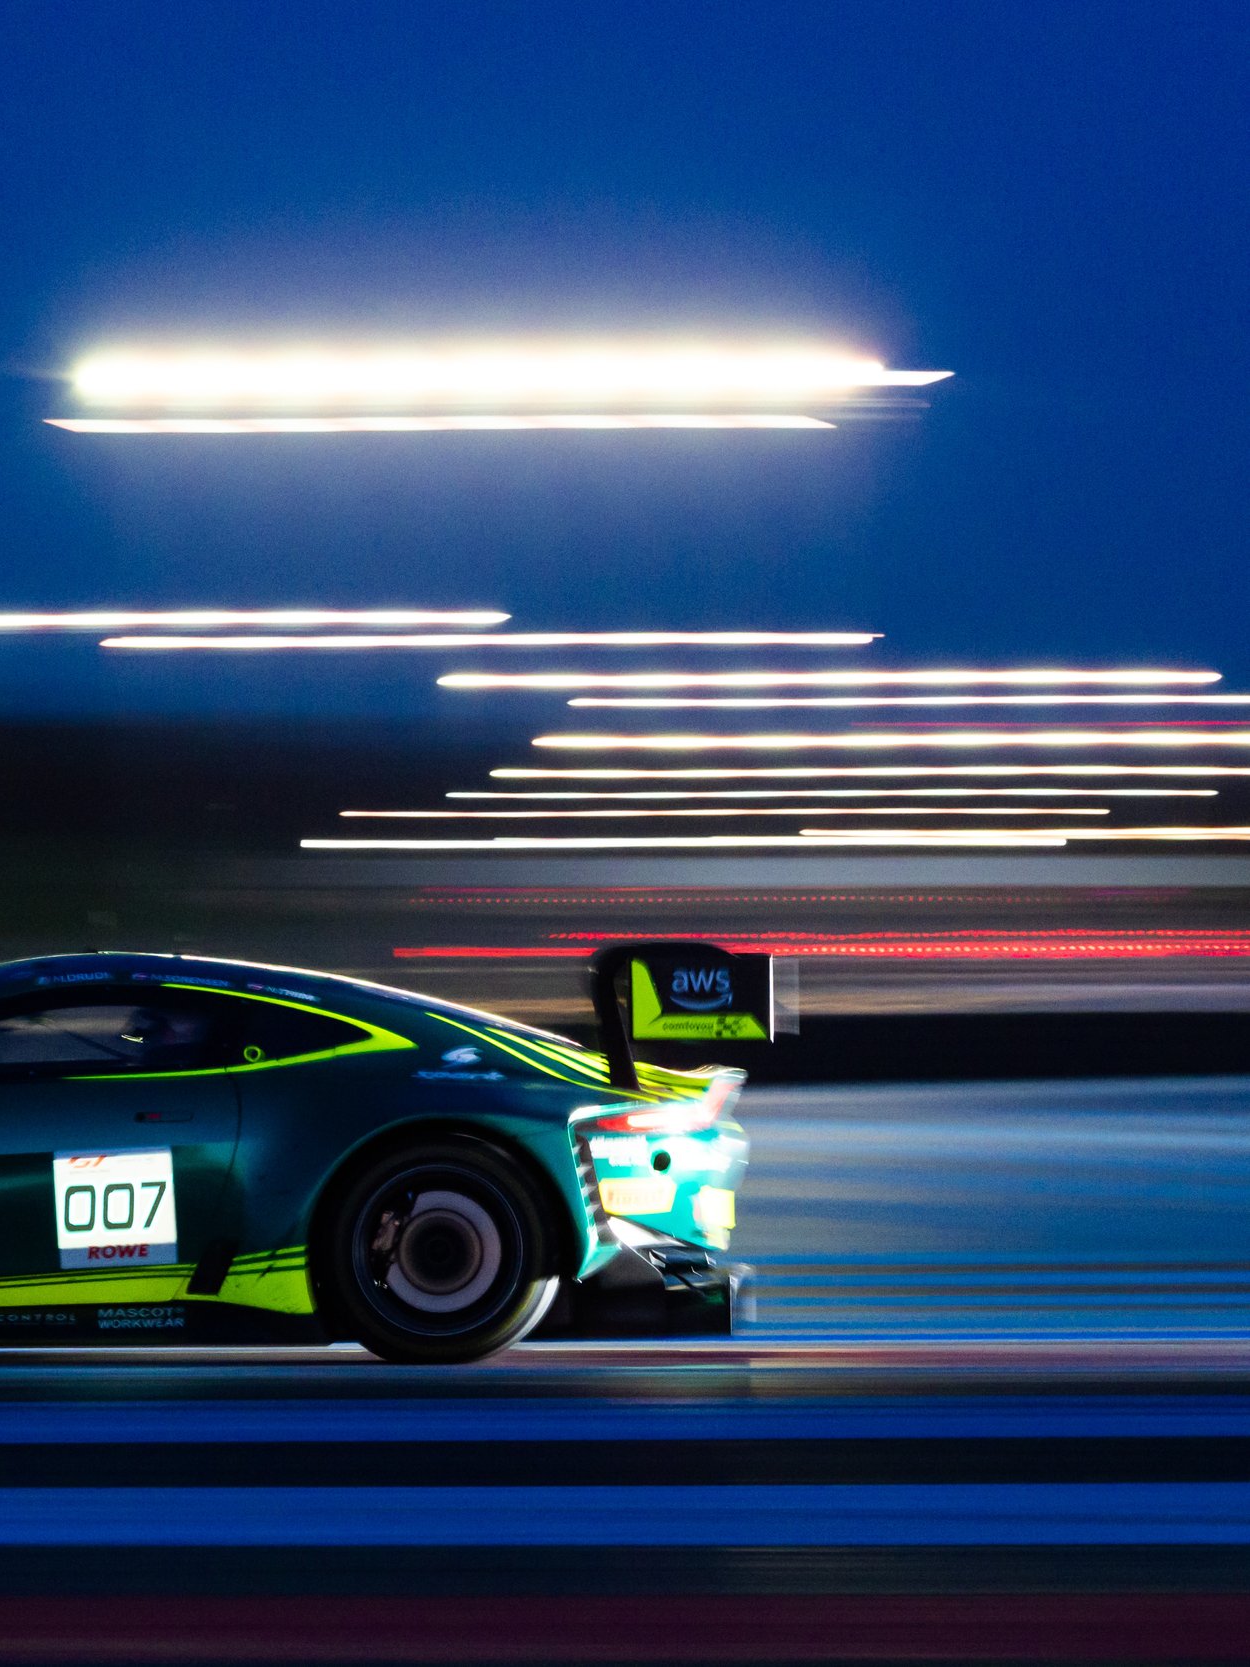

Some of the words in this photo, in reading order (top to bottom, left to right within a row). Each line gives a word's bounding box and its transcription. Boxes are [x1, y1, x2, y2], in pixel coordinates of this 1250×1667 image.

[671, 967, 731, 994] aws
[64, 1181, 167, 1232] 007
[88, 1244, 150, 1259] ROWE
[97, 1317, 186, 1329] WORKWEAR
